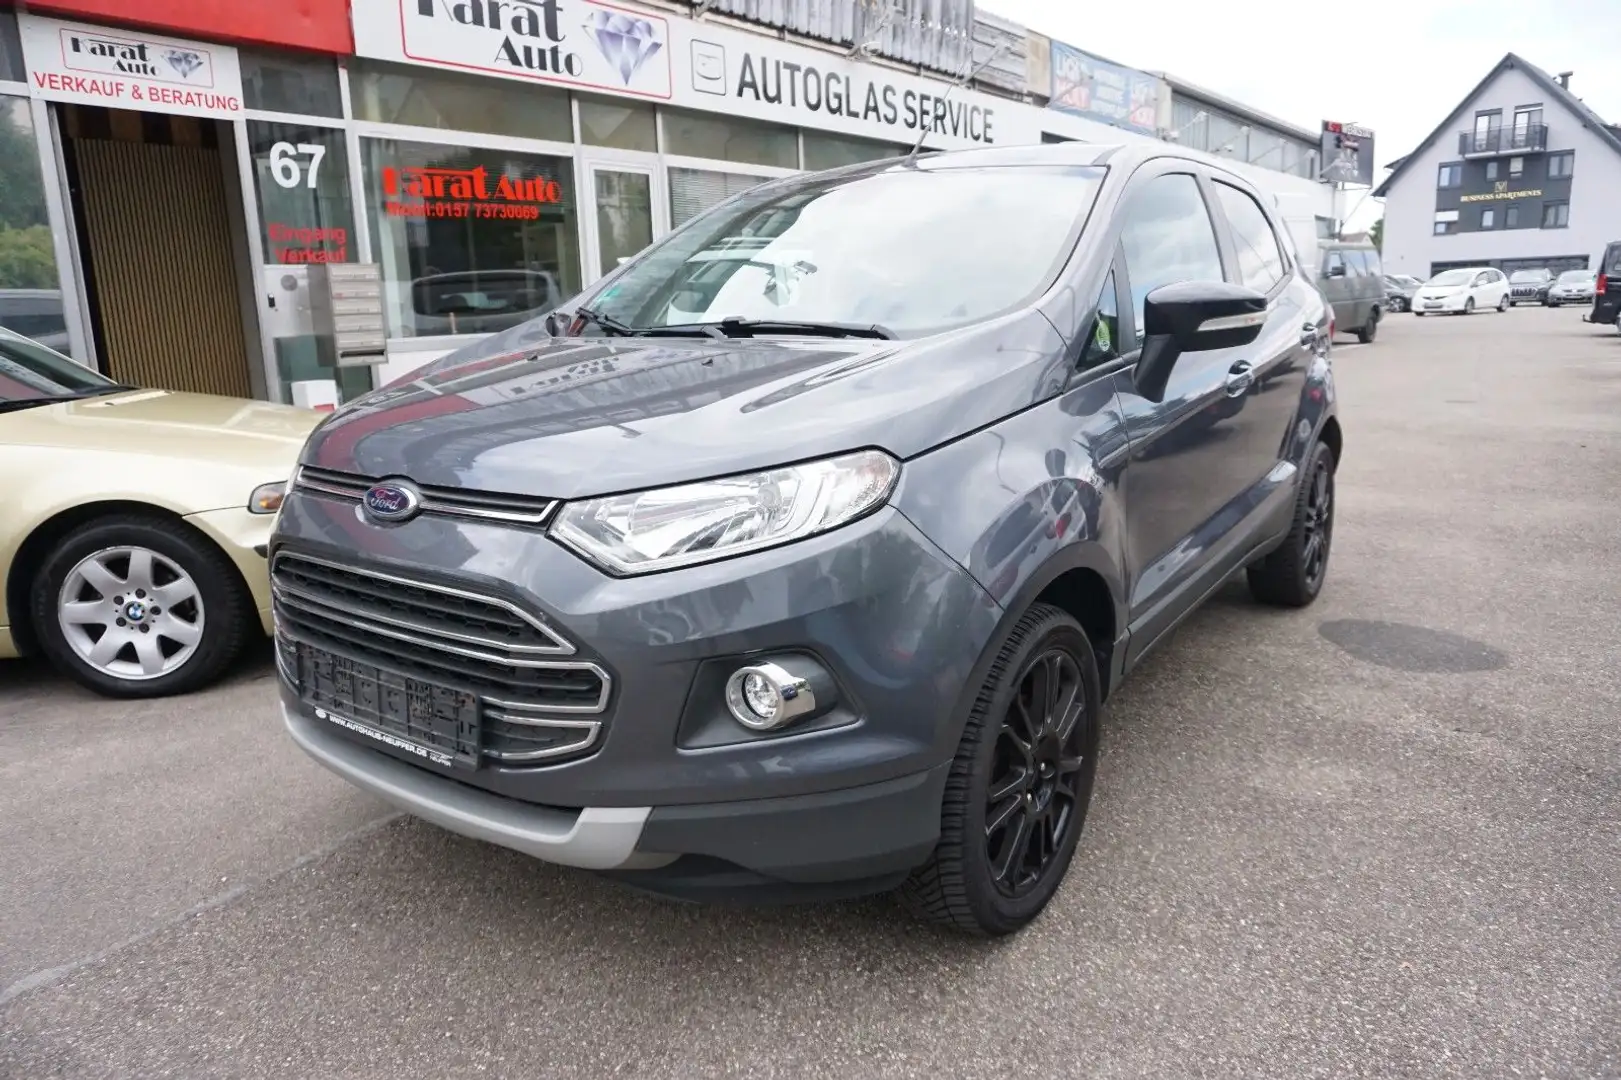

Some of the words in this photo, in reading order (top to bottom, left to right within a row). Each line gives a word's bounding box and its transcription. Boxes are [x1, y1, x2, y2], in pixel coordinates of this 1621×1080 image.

[70, 37, 150, 62] Karat
[494, 35, 584, 77] Auto
[112, 59, 162, 77] Auto
[33, 71, 125, 97] VERKAUF
[131, 83, 144, 101] &
[148, 86, 240, 112] BERATUNG
[269, 141, 326, 189] 67
[494, 174, 562, 204] Auto
[268, 221, 346, 245] Eingang
[275, 246, 348, 264] Verkauf
[370, 489, 402, 510] Ford
